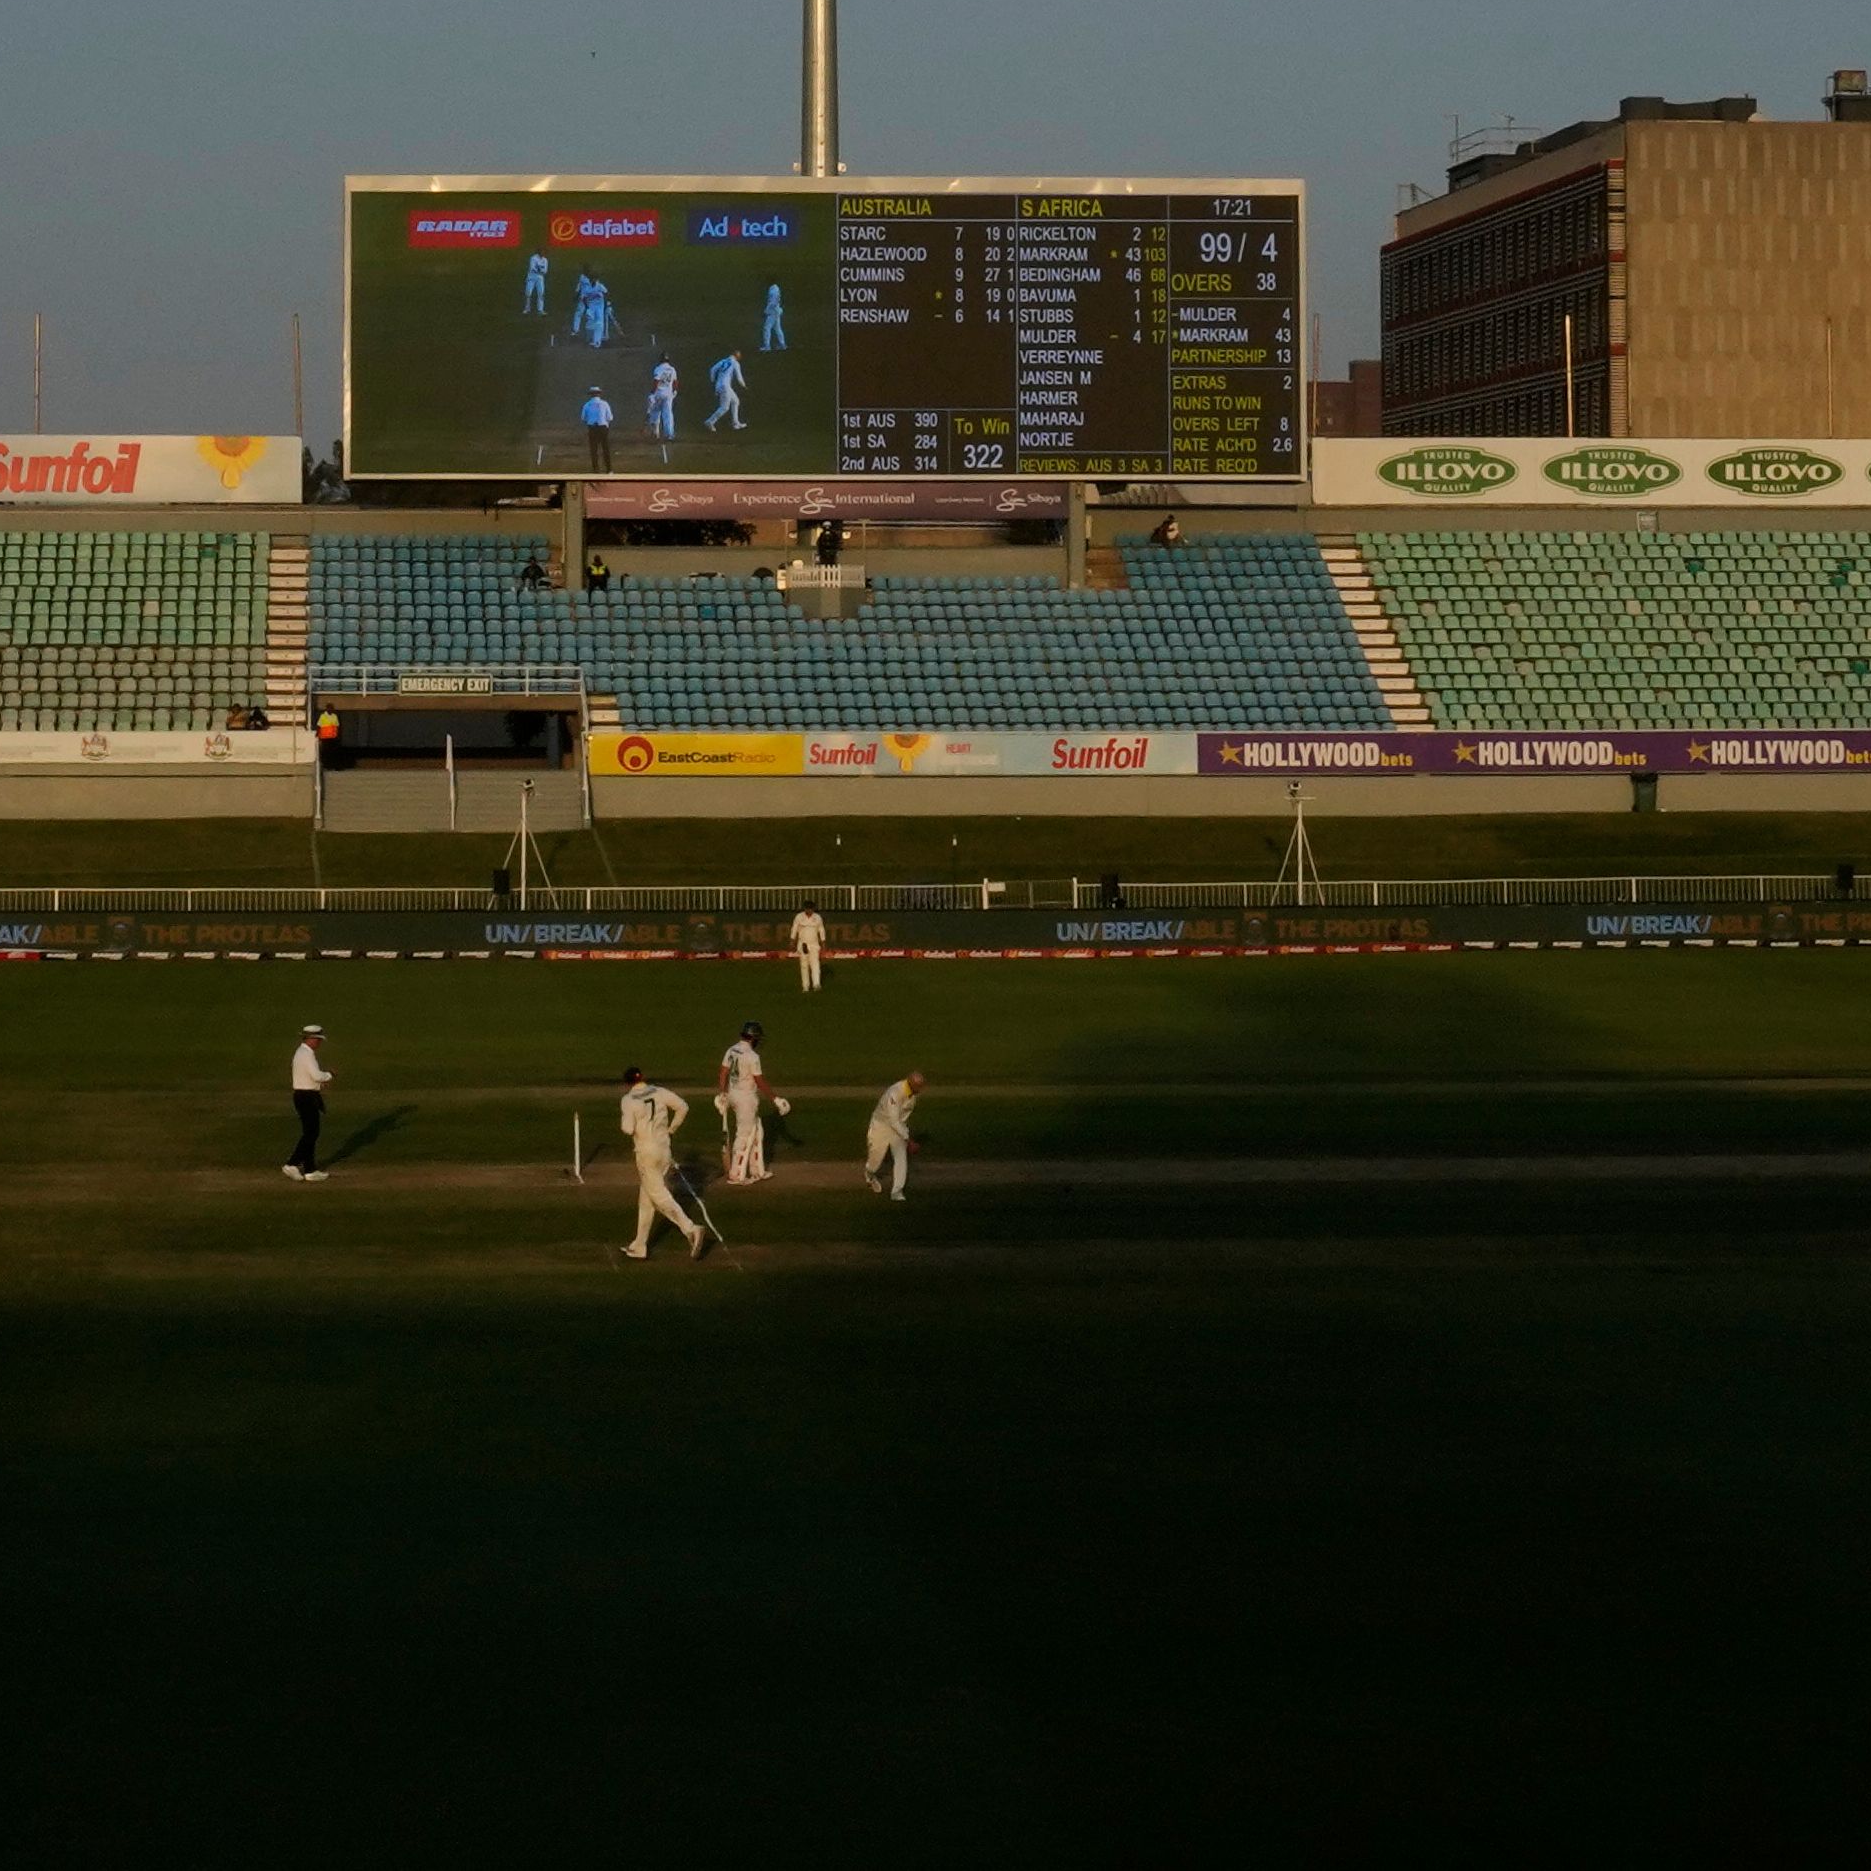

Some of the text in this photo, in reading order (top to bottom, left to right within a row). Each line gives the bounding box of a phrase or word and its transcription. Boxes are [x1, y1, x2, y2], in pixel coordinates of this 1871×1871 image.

[841, 199, 932, 216] AUSTRALIA
[1022, 200, 1103, 217] S AFRICA
[1213, 200, 1251, 217] 17:21
[580, 219, 655, 238] dafabet
[699, 216, 787, 237] Ad tech
[840, 227, 1014, 240] STARC 7 19 0
[1020, 227, 1166, 241] RICKELTON 2 12
[840, 247, 1014, 261] HAZLEWOOD 8 20 2
[1020, 248, 1166, 261] MARKRAM 43 103
[1261, 233, 1277, 262] 4
[840, 268, 1014, 282] CUMMINS 9 27 1
[1020, 268, 1166, 282] BEDINGHAM 46 68
[1172, 273, 1276, 291] OVERS 38
[840, 289, 1014, 302] LYON 8 19 0
[1020, 289, 1166, 302] BAVUMA 1 18
[840, 309, 1014, 322] RENSHAW 6 14 1
[1020, 309, 1166, 322] STUBBS 1 12
[1283, 308, 1290, 321] 4
[1020, 330, 1166, 343] MULDER 4 17
[1275, 329, 1291, 343] 43
[1020, 350, 1103, 364] VERREYNNE
[1172, 349, 1291, 363] PARTNERSHIP 13
[1020, 371, 1091, 385] JANSEN M
[1173, 376, 1291, 390] EXTRAS 2
[1020, 392, 1078, 405] HARMER
[1173, 397, 1261, 410] RUNS TO WIN
[842, 413, 938, 427] 1st AUS 390
[1020, 412, 1084, 425] MAHARAJ
[1173, 418, 1288, 431] OVERS LEFT 8
[954, 418, 1009, 434] To Win
[842, 435, 937, 448] 1st SA 284
[1020, 433, 1073, 446] NORTJE
[1173, 439, 1209, 451] RATE
[1273, 439, 1292, 452] 2.6
[964, 444, 1003, 468] 322
[842, 457, 937, 470] 2nd AUS 314
[1020, 460, 1162, 471] REVIEWS: AUS 3 SA 3
[1173, 459, 1209, 472] RATE
[1396, 462, 1506, 482] ILLOVO
[1561, 462, 1670, 482] ILLOVO
[1725, 462, 1832, 482] ILLOVO
[733, 493, 801, 505] Experience
[835, 492, 915, 504] International
[809, 743, 878, 766] Sunfoil
[946, 744, 971, 754] HEART
[1052, 738, 1149, 770] Sunfoil
[1244, 741, 1413, 768] HOLLYWOODbets
[1478, 741, 1647, 768] HOLLYWOODbets
[644, 1098, 655, 1121] 7
